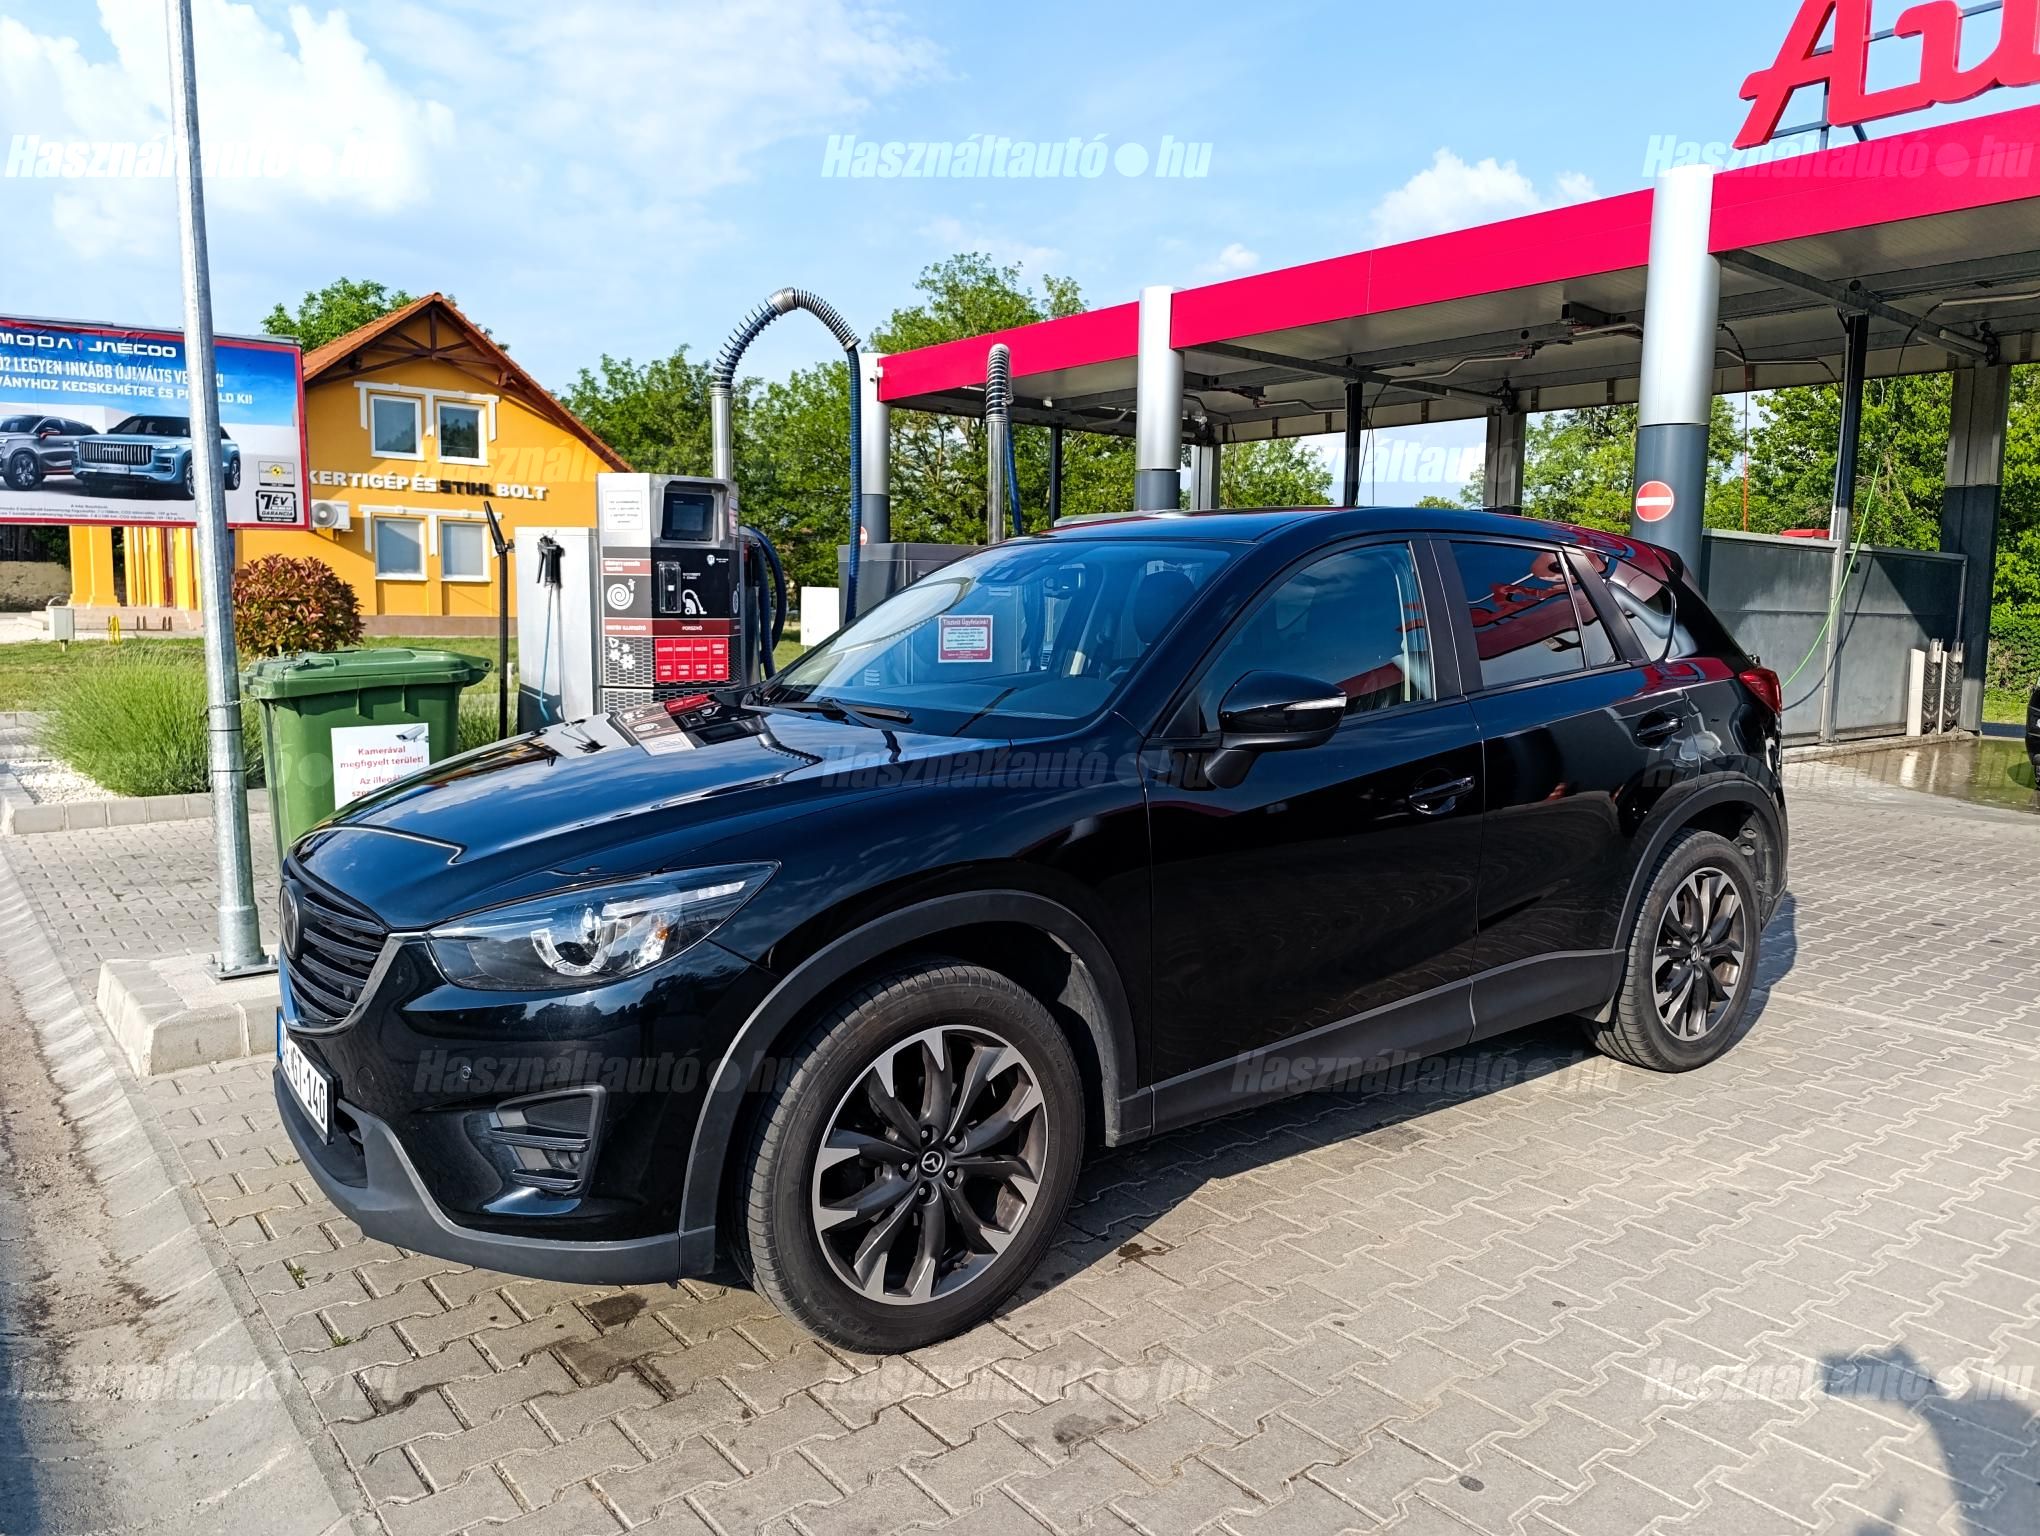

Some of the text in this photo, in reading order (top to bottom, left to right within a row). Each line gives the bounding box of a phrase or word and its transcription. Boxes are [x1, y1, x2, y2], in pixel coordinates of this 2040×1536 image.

[88, 341, 177, 359] JAECOO
[14, 357, 62, 375] LEGYEN
[65, 361, 112, 378] INKÁBB
[62, 380, 155, 398] KECSKEMÉTRE
[158, 385, 174, 399] ÉS
[309, 470, 548, 500] KERTIGÉP ÉS STIHL BOLT
[260, 494, 288, 510] 7 ÉV
[358, 745, 406, 756] Kamerával
[340, 755, 424, 769] megfigyelt terület!
